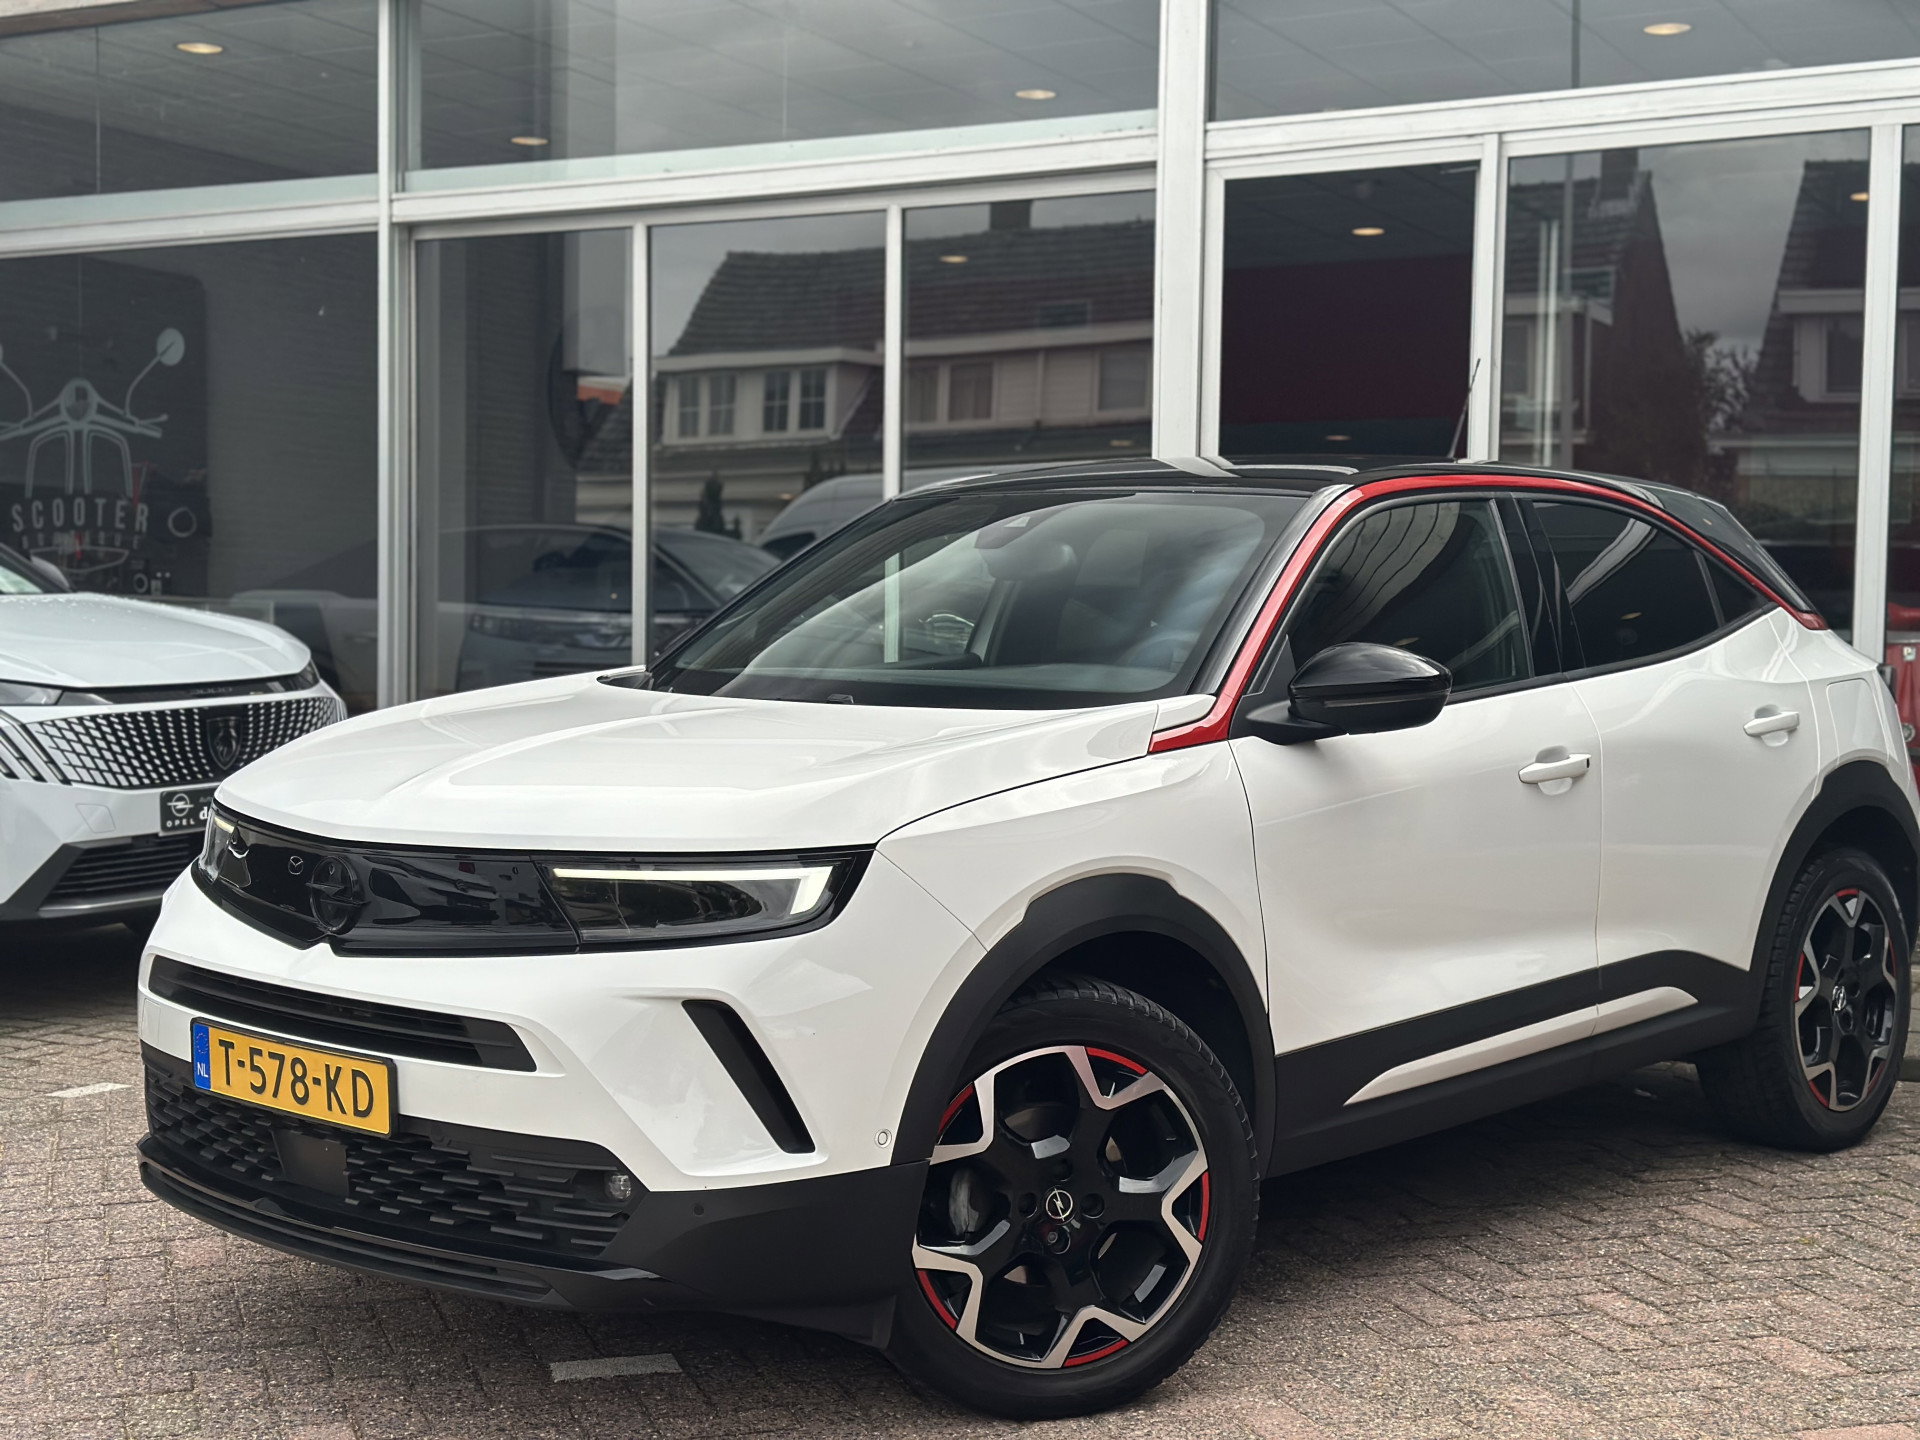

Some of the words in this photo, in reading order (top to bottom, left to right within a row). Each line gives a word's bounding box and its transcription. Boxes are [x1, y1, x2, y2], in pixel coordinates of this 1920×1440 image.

[11, 497, 149, 533] SCOOTER
[166, 818, 195, 828] OPEL
[197, 1062, 209, 1078] NL
[218, 1038, 374, 1118] T-578-KD
